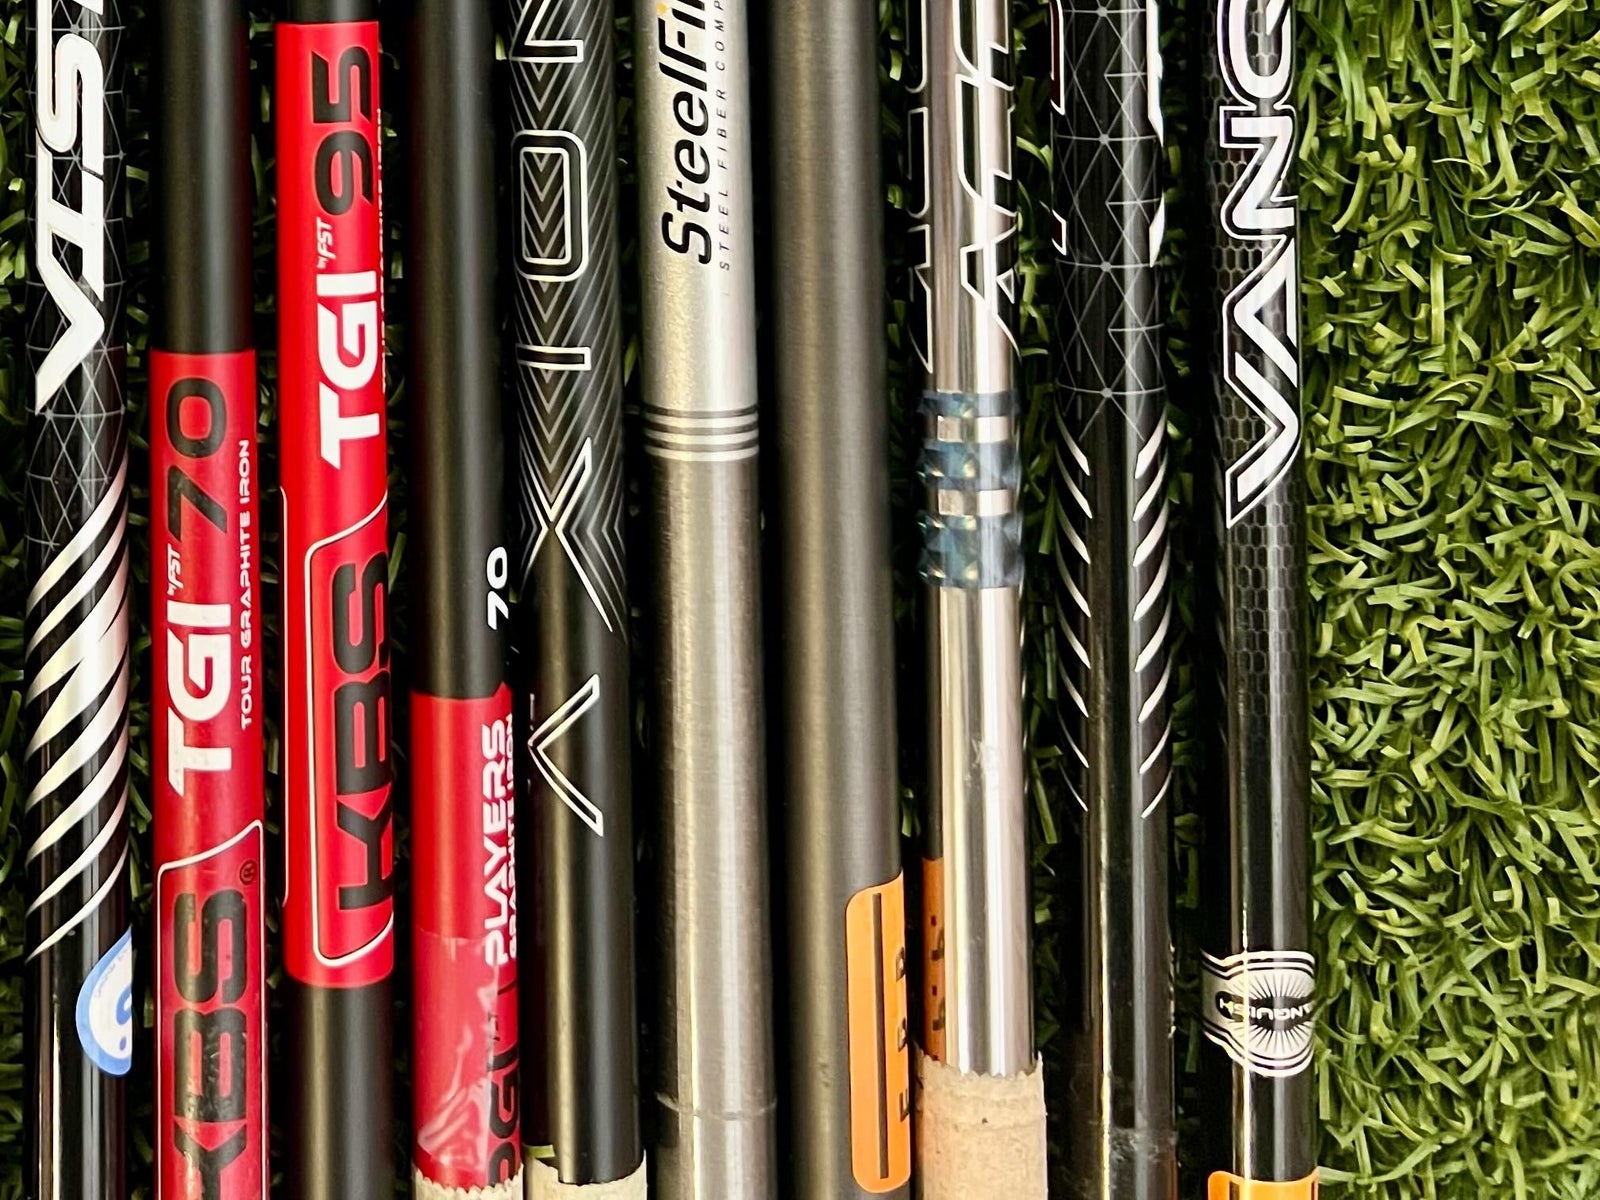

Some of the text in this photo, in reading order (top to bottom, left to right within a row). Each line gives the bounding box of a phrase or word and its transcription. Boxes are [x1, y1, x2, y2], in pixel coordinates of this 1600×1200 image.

[312, 45, 374, 216] 95
[716, 88, 728, 169] FIBER
[718, 189, 730, 271] STEEL
[166, 377, 228, 541] 70
[316, 269, 382, 470] TGI
[238, 439, 252, 731] TOUR GRAPHITE IRON
[486, 547, 509, 632] 70
[166, 599, 233, 797] TGI
[332, 551, 395, 910] KBS
[482, 718, 509, 966] PLAYERS
[173, 889, 248, 1200] KBS
